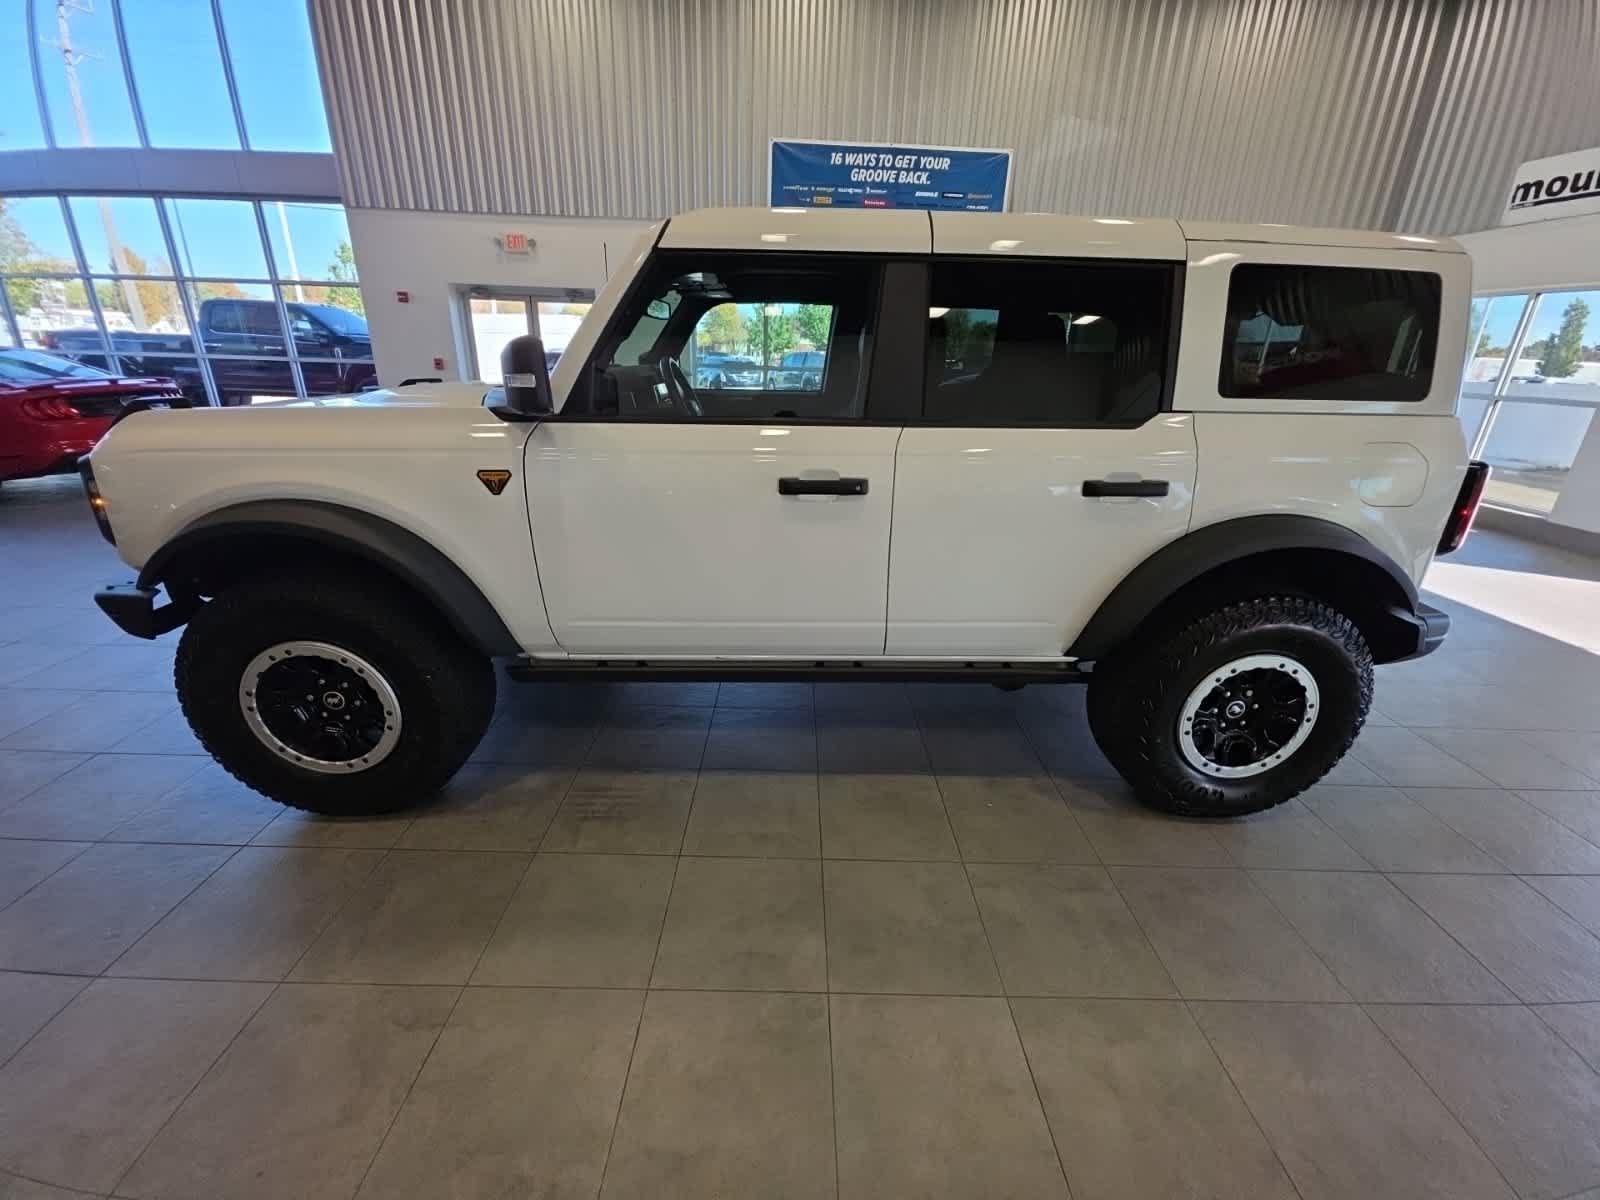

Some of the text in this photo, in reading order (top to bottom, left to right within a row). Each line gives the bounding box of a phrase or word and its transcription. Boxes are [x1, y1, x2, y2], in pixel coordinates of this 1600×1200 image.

[830, 152, 951, 171] 16 WAYS TO GET YOUR
[851, 168, 932, 185] GROOVE BACK.
[1511, 169, 1600, 204] mou
[507, 234, 526, 249] EXIT
